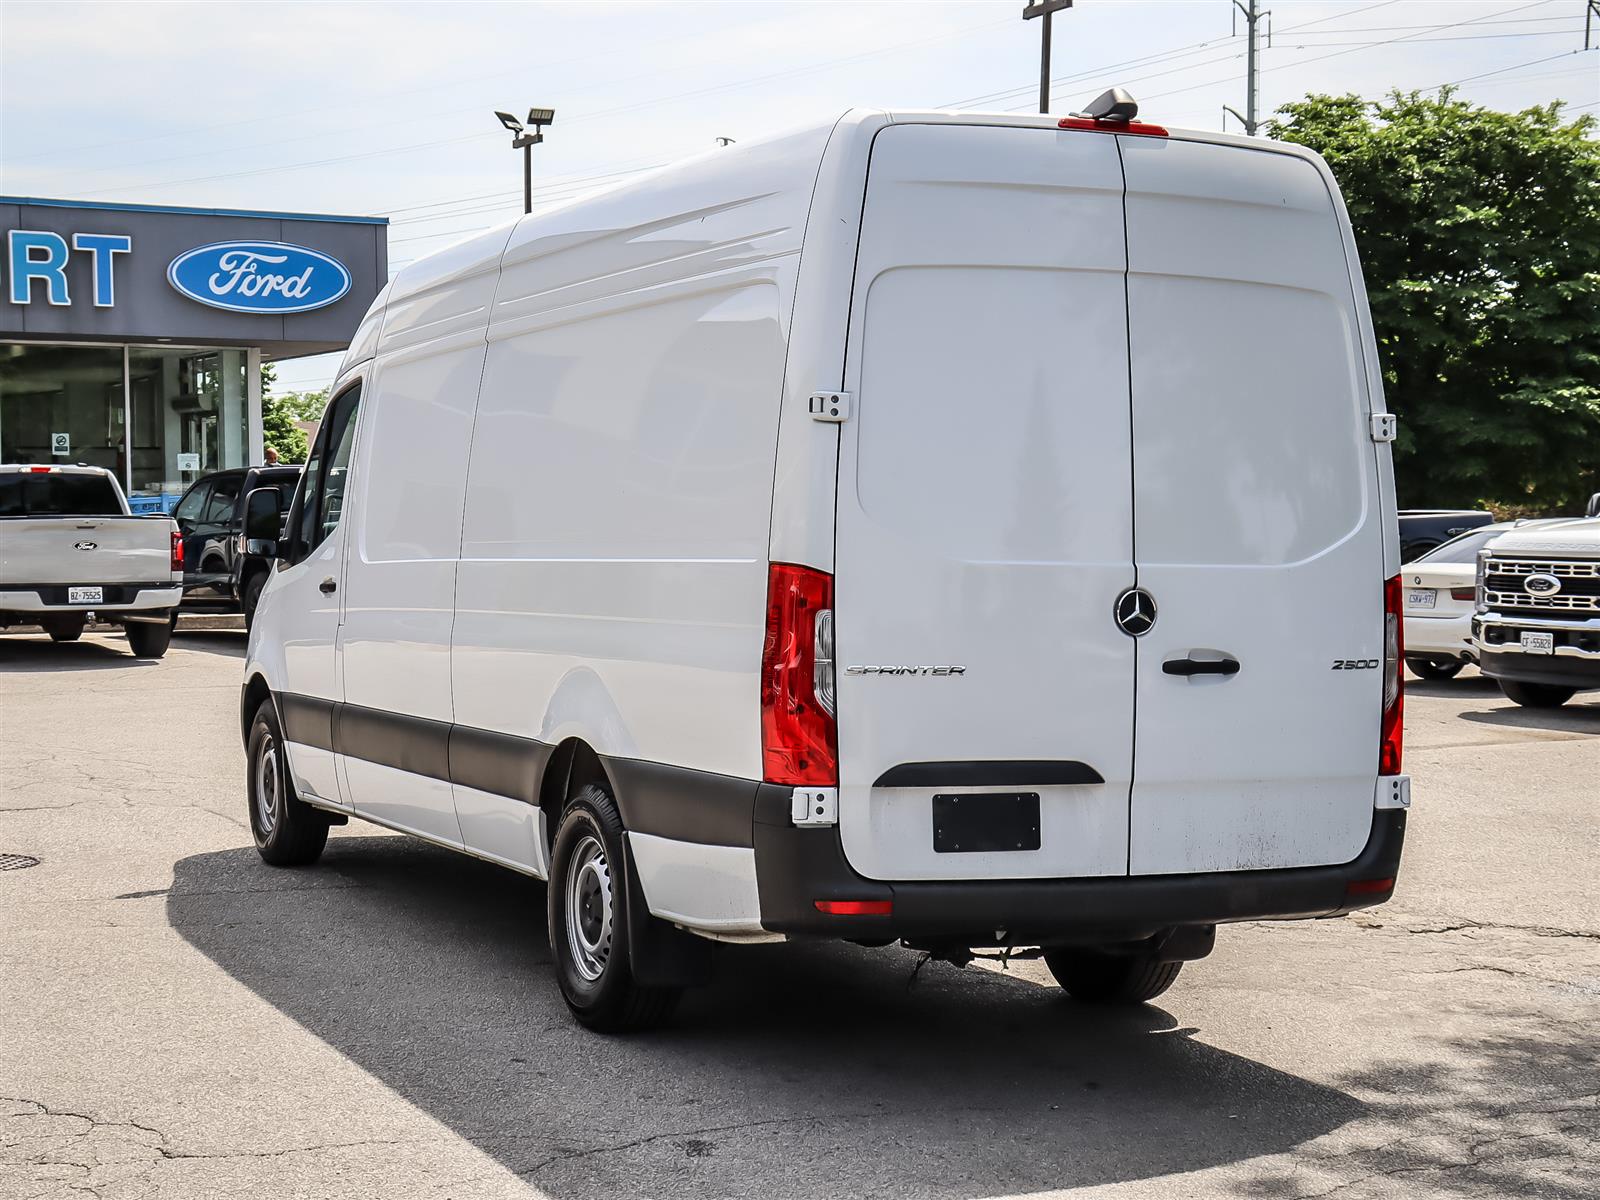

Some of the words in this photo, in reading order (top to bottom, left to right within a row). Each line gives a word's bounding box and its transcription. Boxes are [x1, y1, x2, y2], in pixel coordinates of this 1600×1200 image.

[8, 230, 132, 307] RT
[208, 250, 314, 299] Ford
[845, 665, 967, 676] SPRINTER
[1331, 659, 1379, 670] 2500
